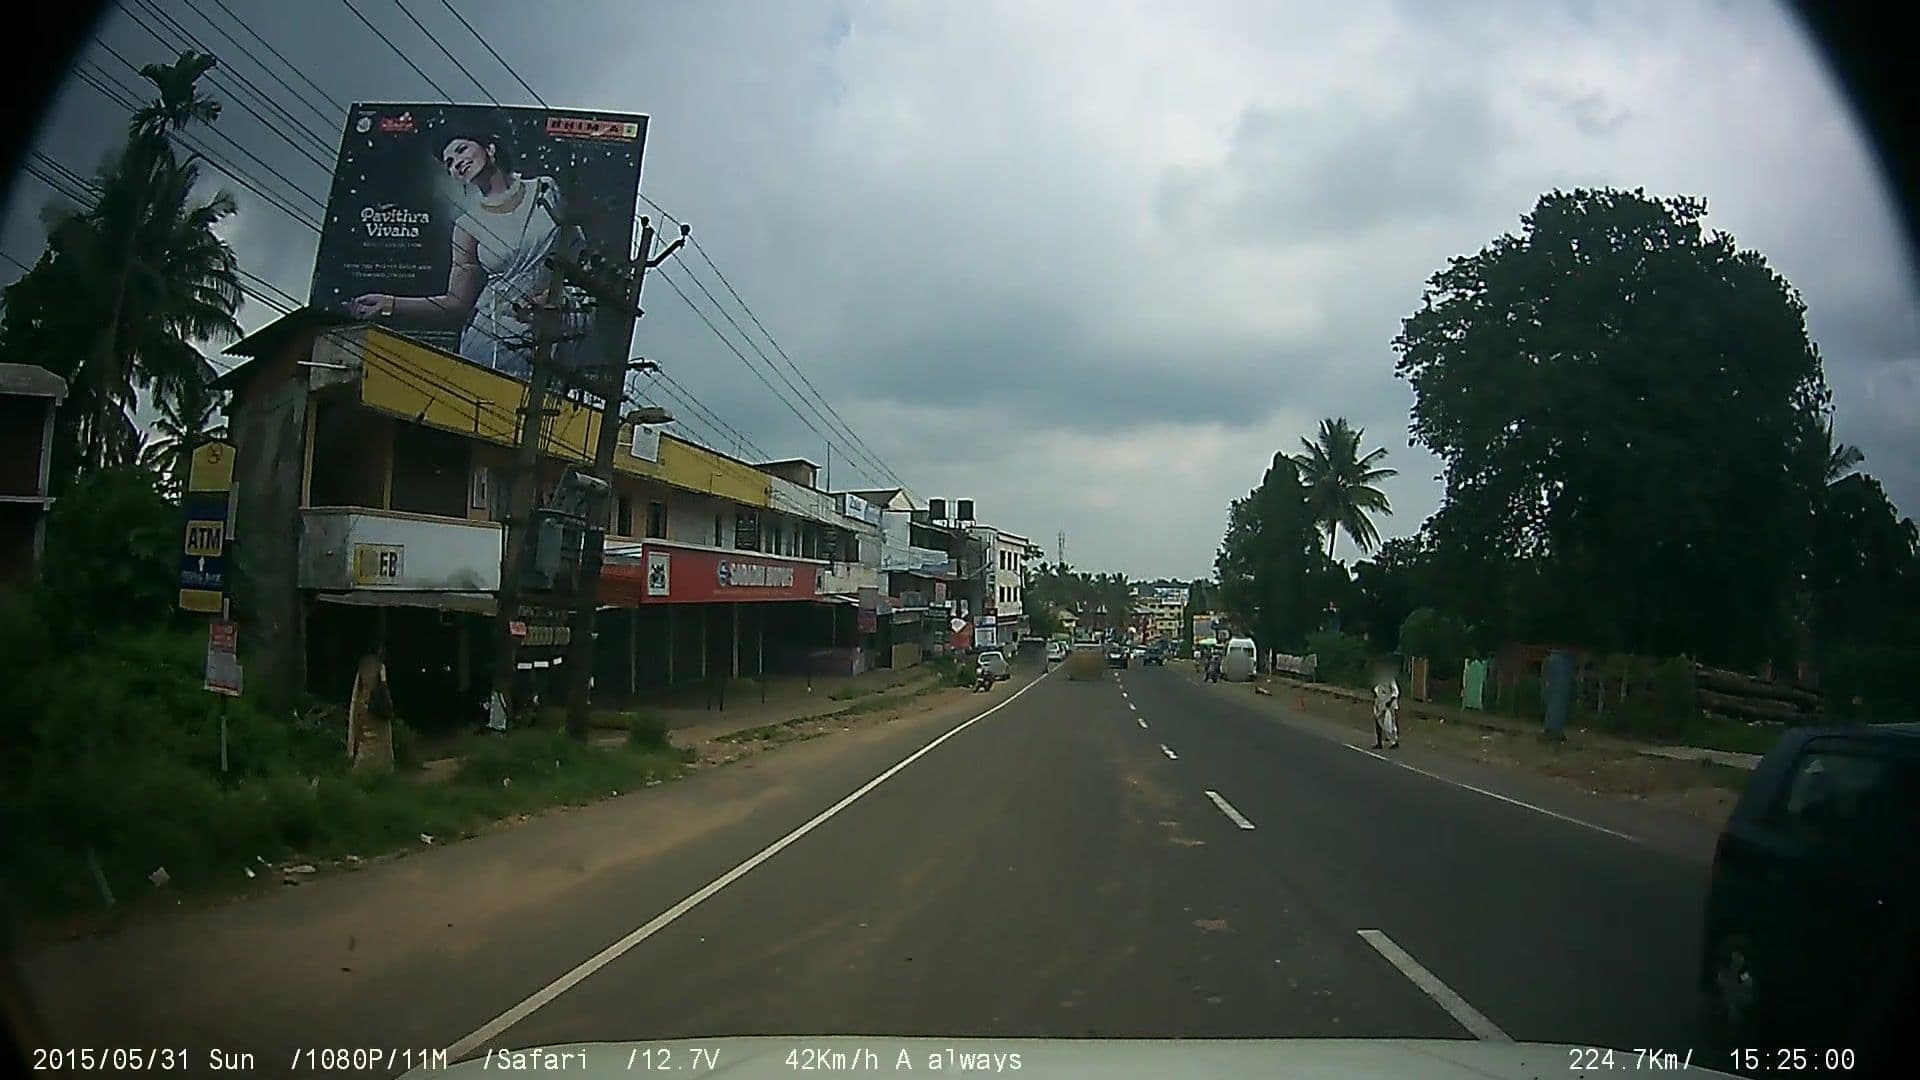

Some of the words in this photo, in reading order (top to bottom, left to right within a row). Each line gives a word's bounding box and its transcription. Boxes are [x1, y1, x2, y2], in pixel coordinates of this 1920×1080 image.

[360, 207, 430, 224] Pavithra
[366, 223, 420, 238] Vivaha
[187, 527, 221, 549] ATM
